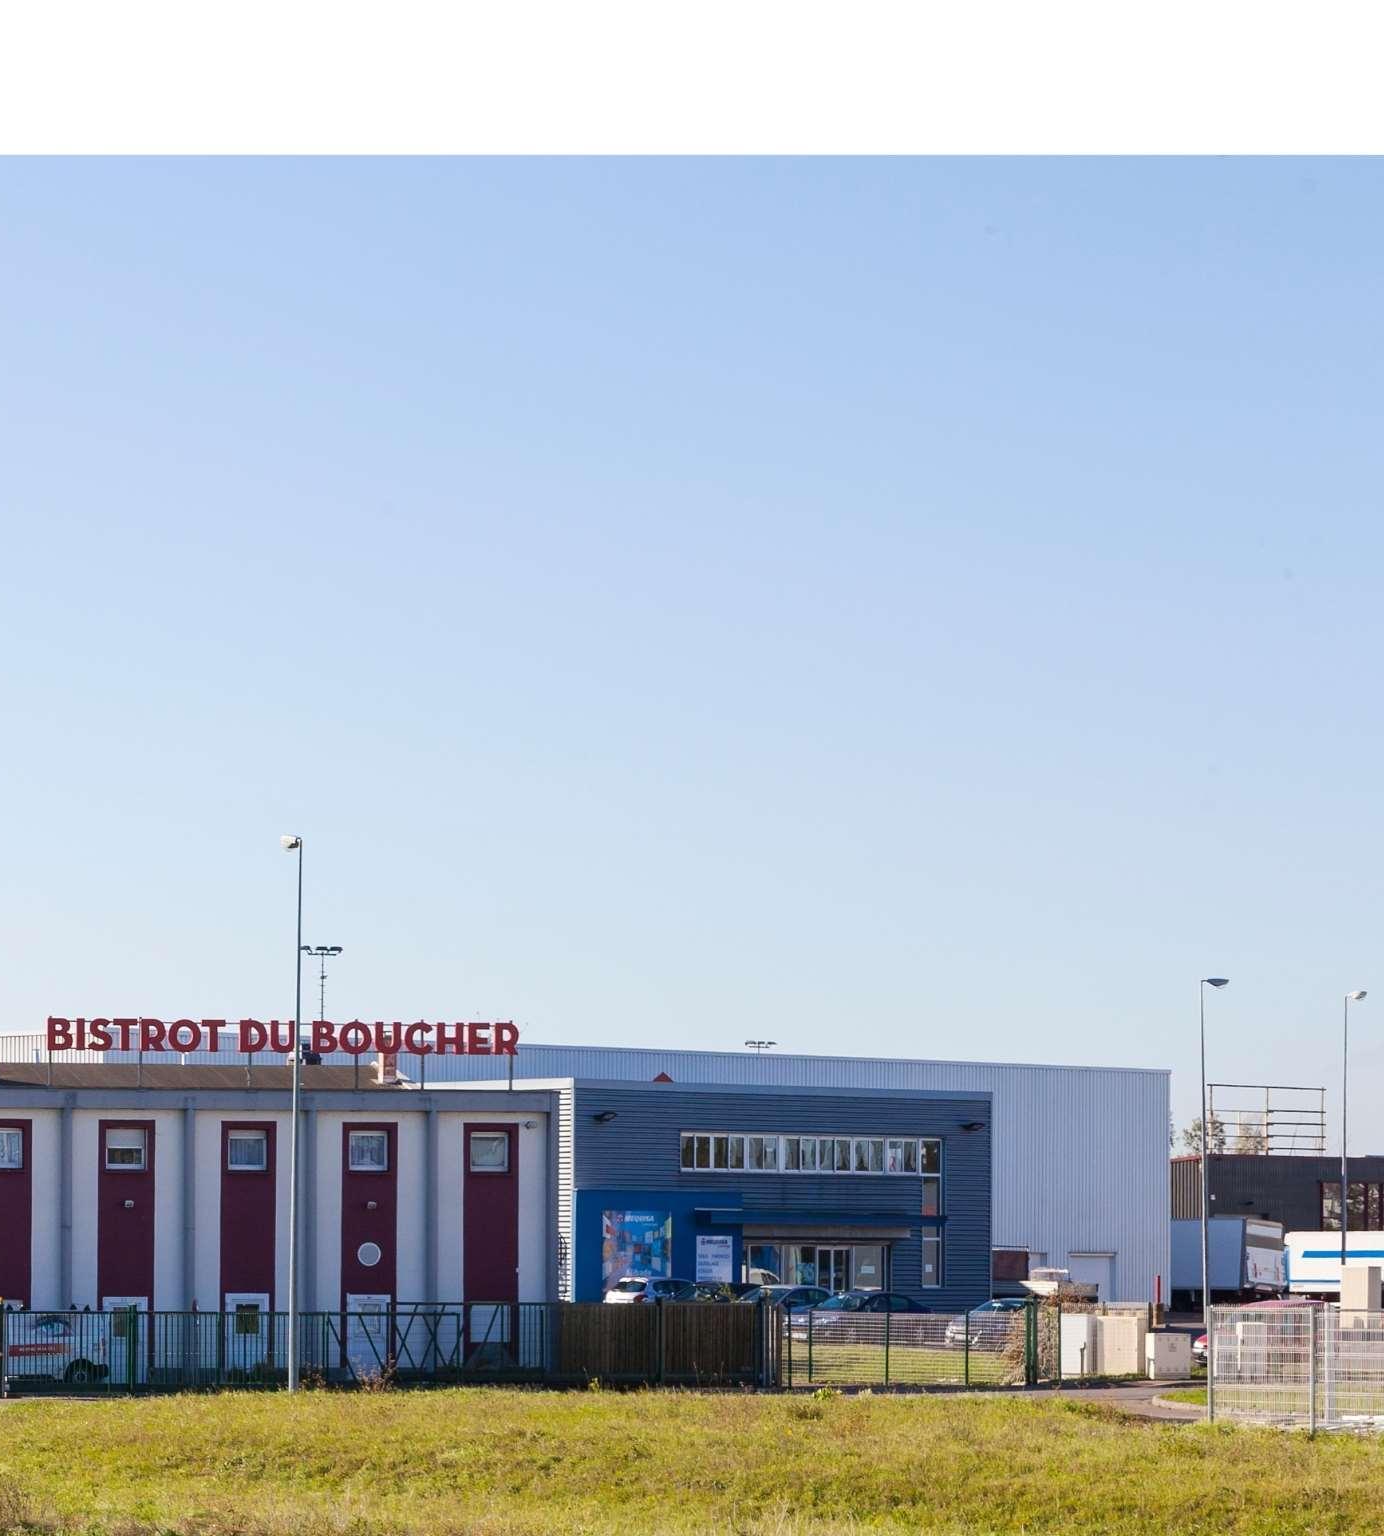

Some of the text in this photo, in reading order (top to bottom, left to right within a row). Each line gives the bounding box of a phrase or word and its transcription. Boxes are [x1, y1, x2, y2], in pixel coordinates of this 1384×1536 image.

[47, 1017, 519, 1056] BISTROT DU BOUCHER
